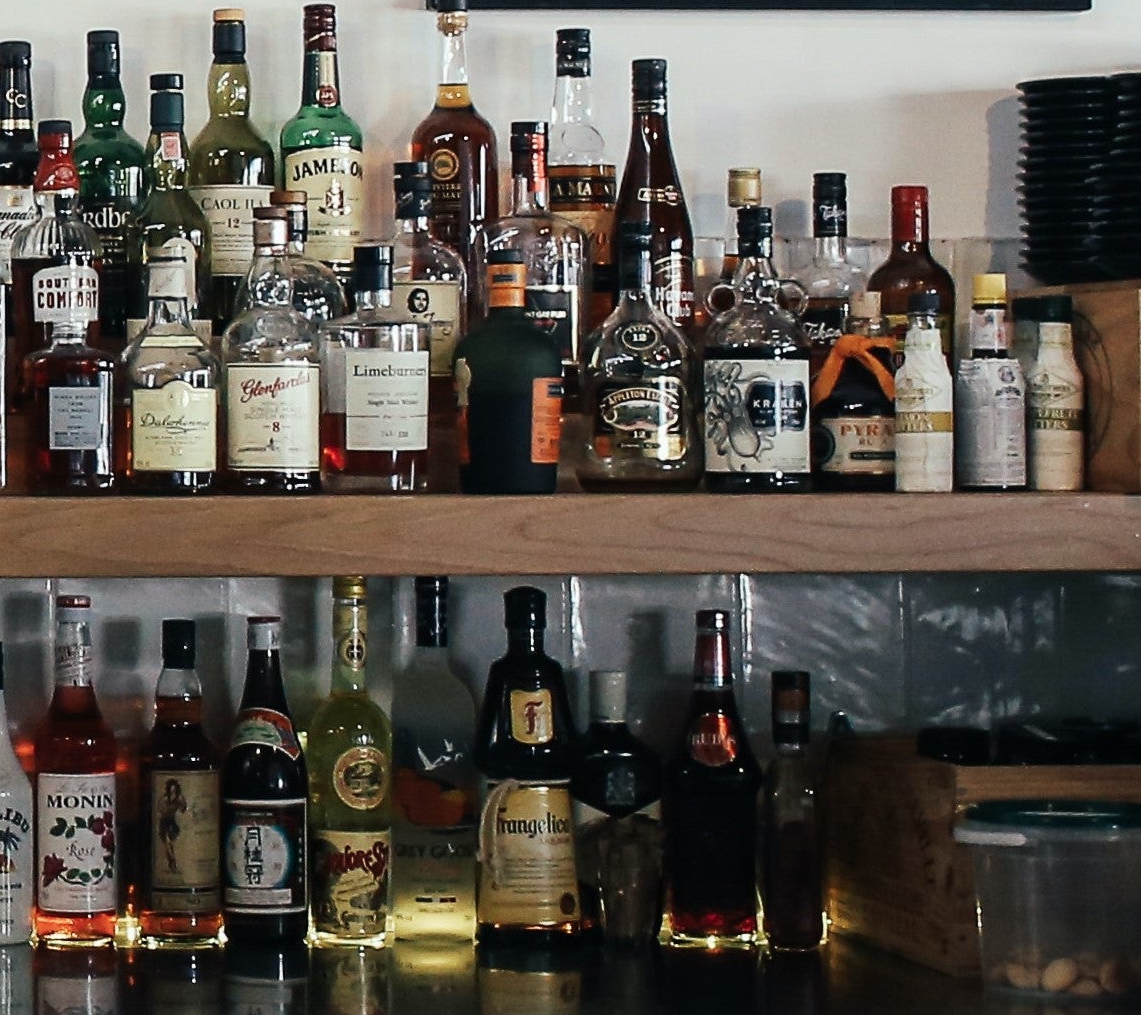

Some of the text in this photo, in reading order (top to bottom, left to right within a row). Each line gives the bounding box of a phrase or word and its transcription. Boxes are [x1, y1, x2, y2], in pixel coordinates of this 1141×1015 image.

[200, 197, 241, 211] CAOL
[227, 217, 241, 229] 12
[271, 421, 281, 433] 8
[46, 794, 114, 809] MONIN
